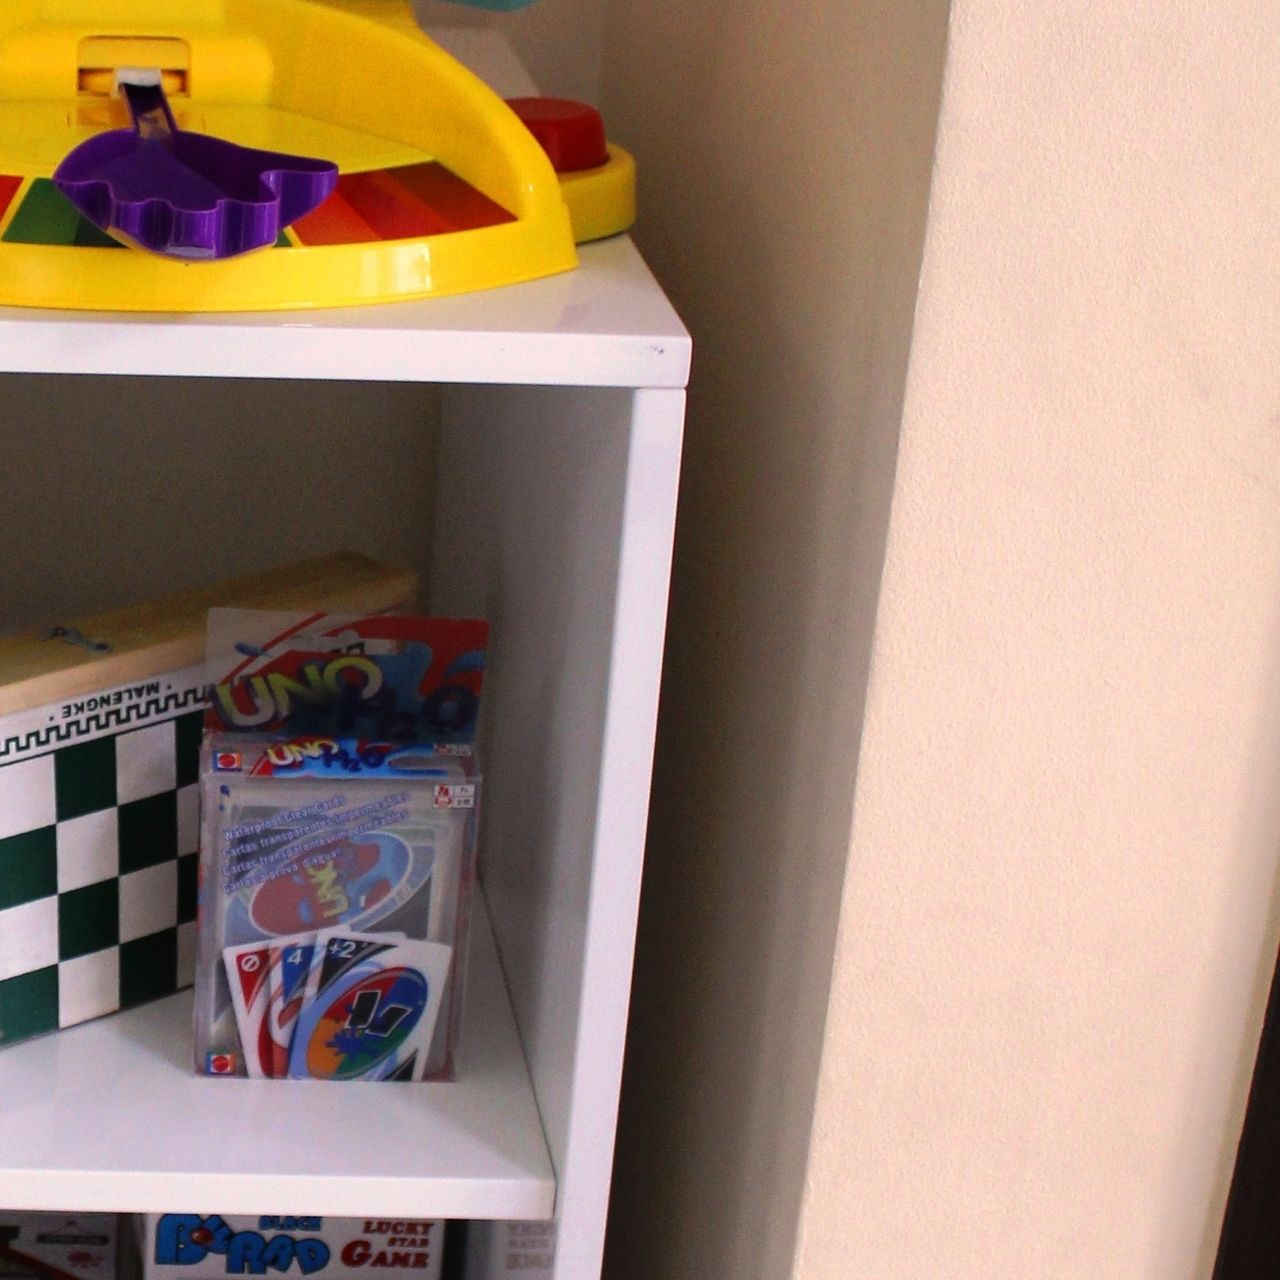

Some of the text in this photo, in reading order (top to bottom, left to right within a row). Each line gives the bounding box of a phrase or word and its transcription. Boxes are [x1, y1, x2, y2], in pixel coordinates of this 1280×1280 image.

[62, 682, 160, 718] MALENGKE
[215, 656, 384, 727] UNO
[267, 741, 339, 766] UNO
[287, 949, 303, 965] 4
[329, 940, 356, 959] +2
[363, 1221, 434, 1236] LUCKY
[388, 1237, 429, 1249] STAB
[341, 1240, 429, 1269] GAME
